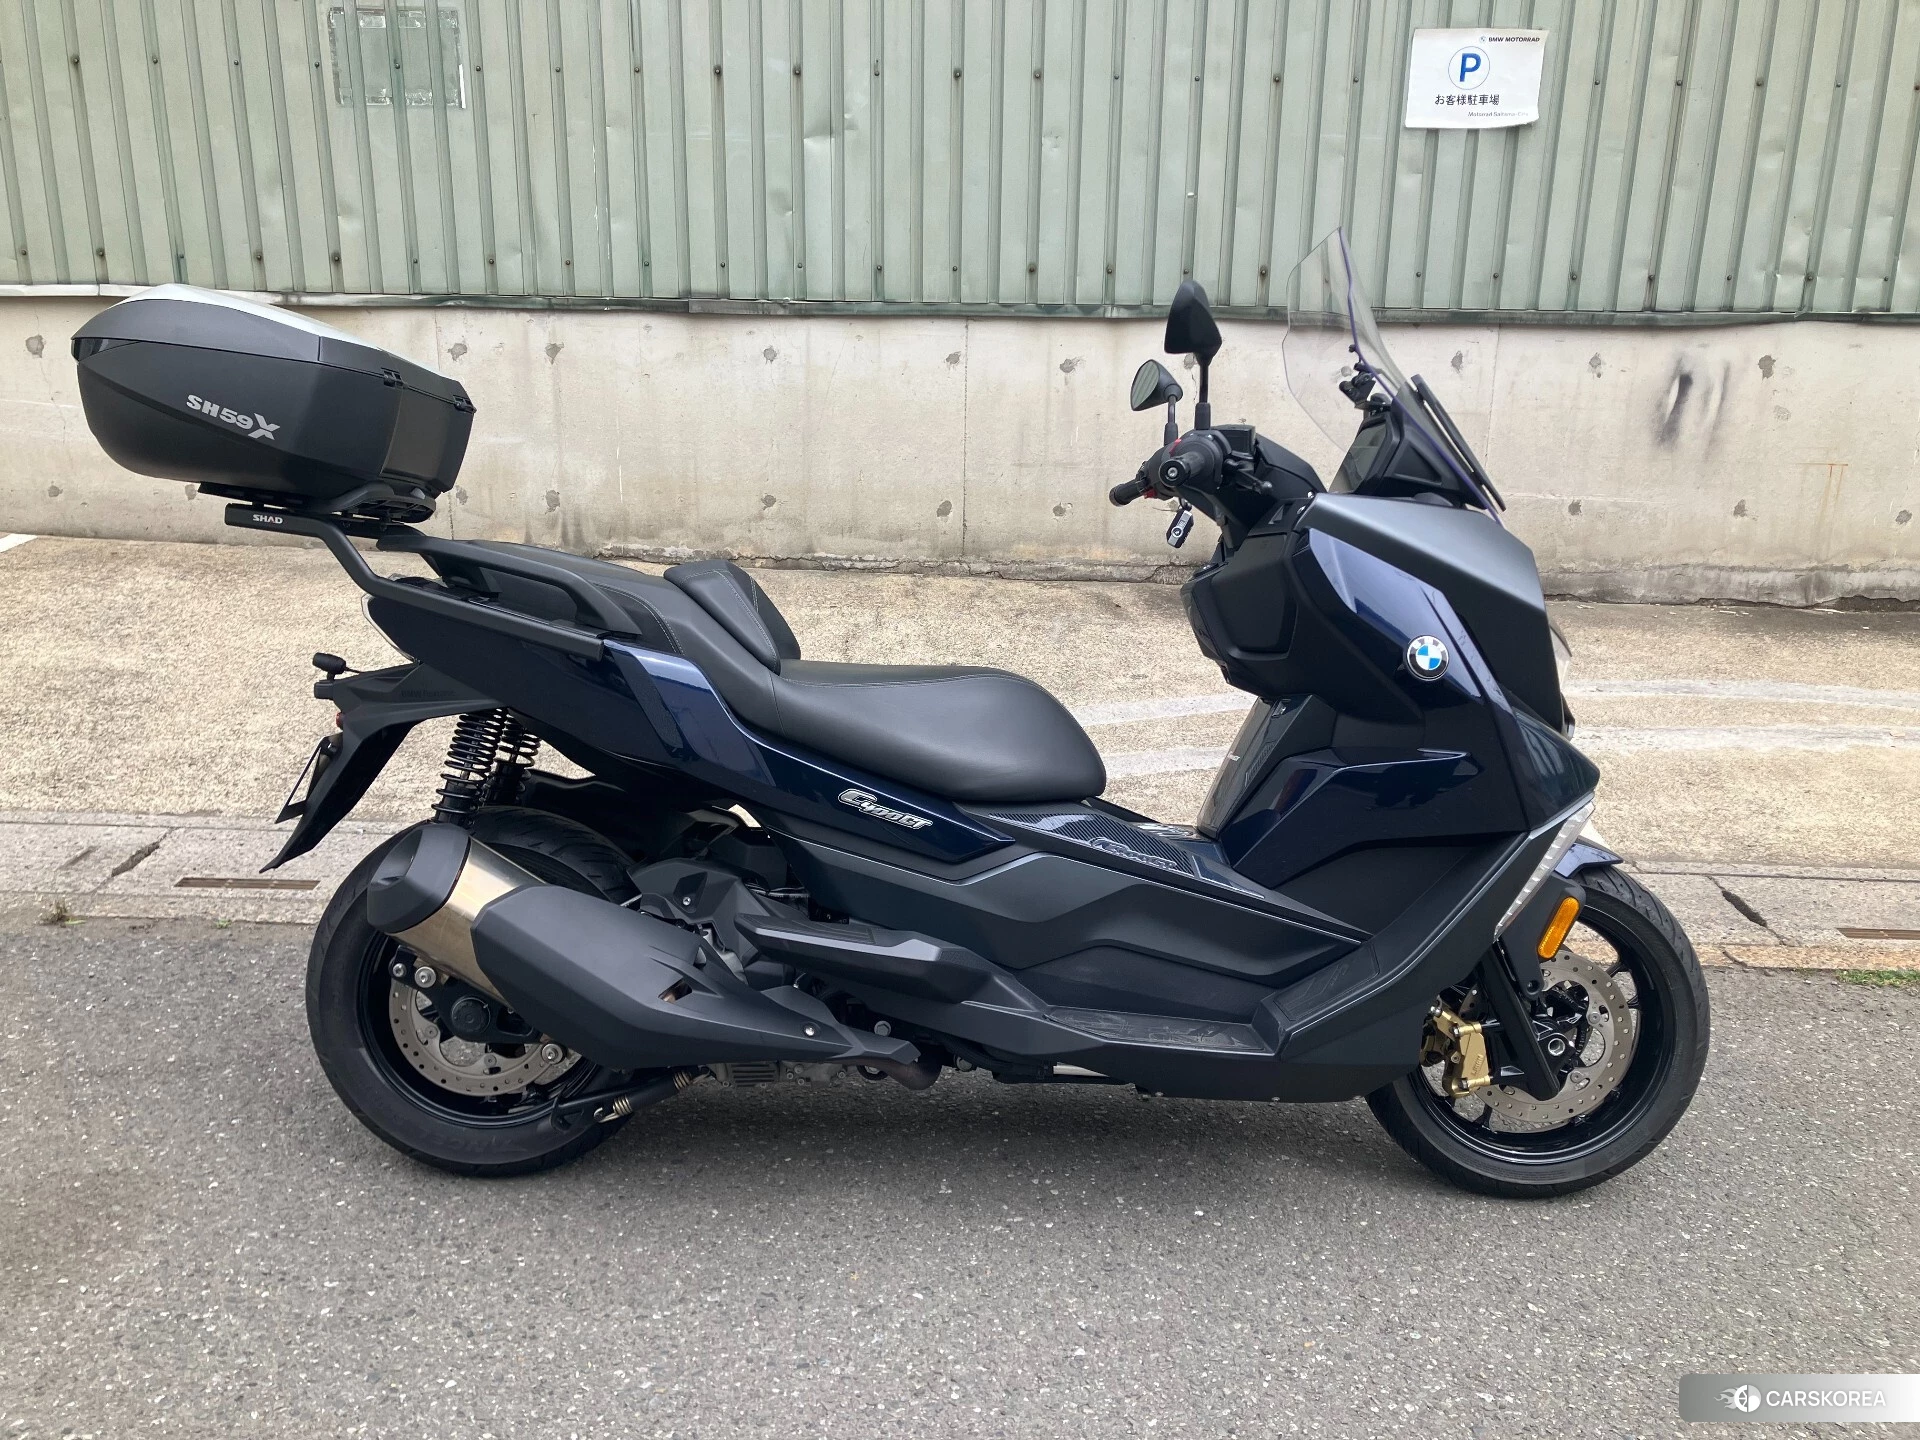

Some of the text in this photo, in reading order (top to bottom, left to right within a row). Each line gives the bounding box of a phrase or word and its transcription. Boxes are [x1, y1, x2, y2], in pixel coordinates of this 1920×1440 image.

[1459, 53, 1481, 82] P
[1434, 94, 1500, 106] お客様駐車場
[186, 394, 280, 440] SH59X
[252, 514, 283, 524] SHAD
